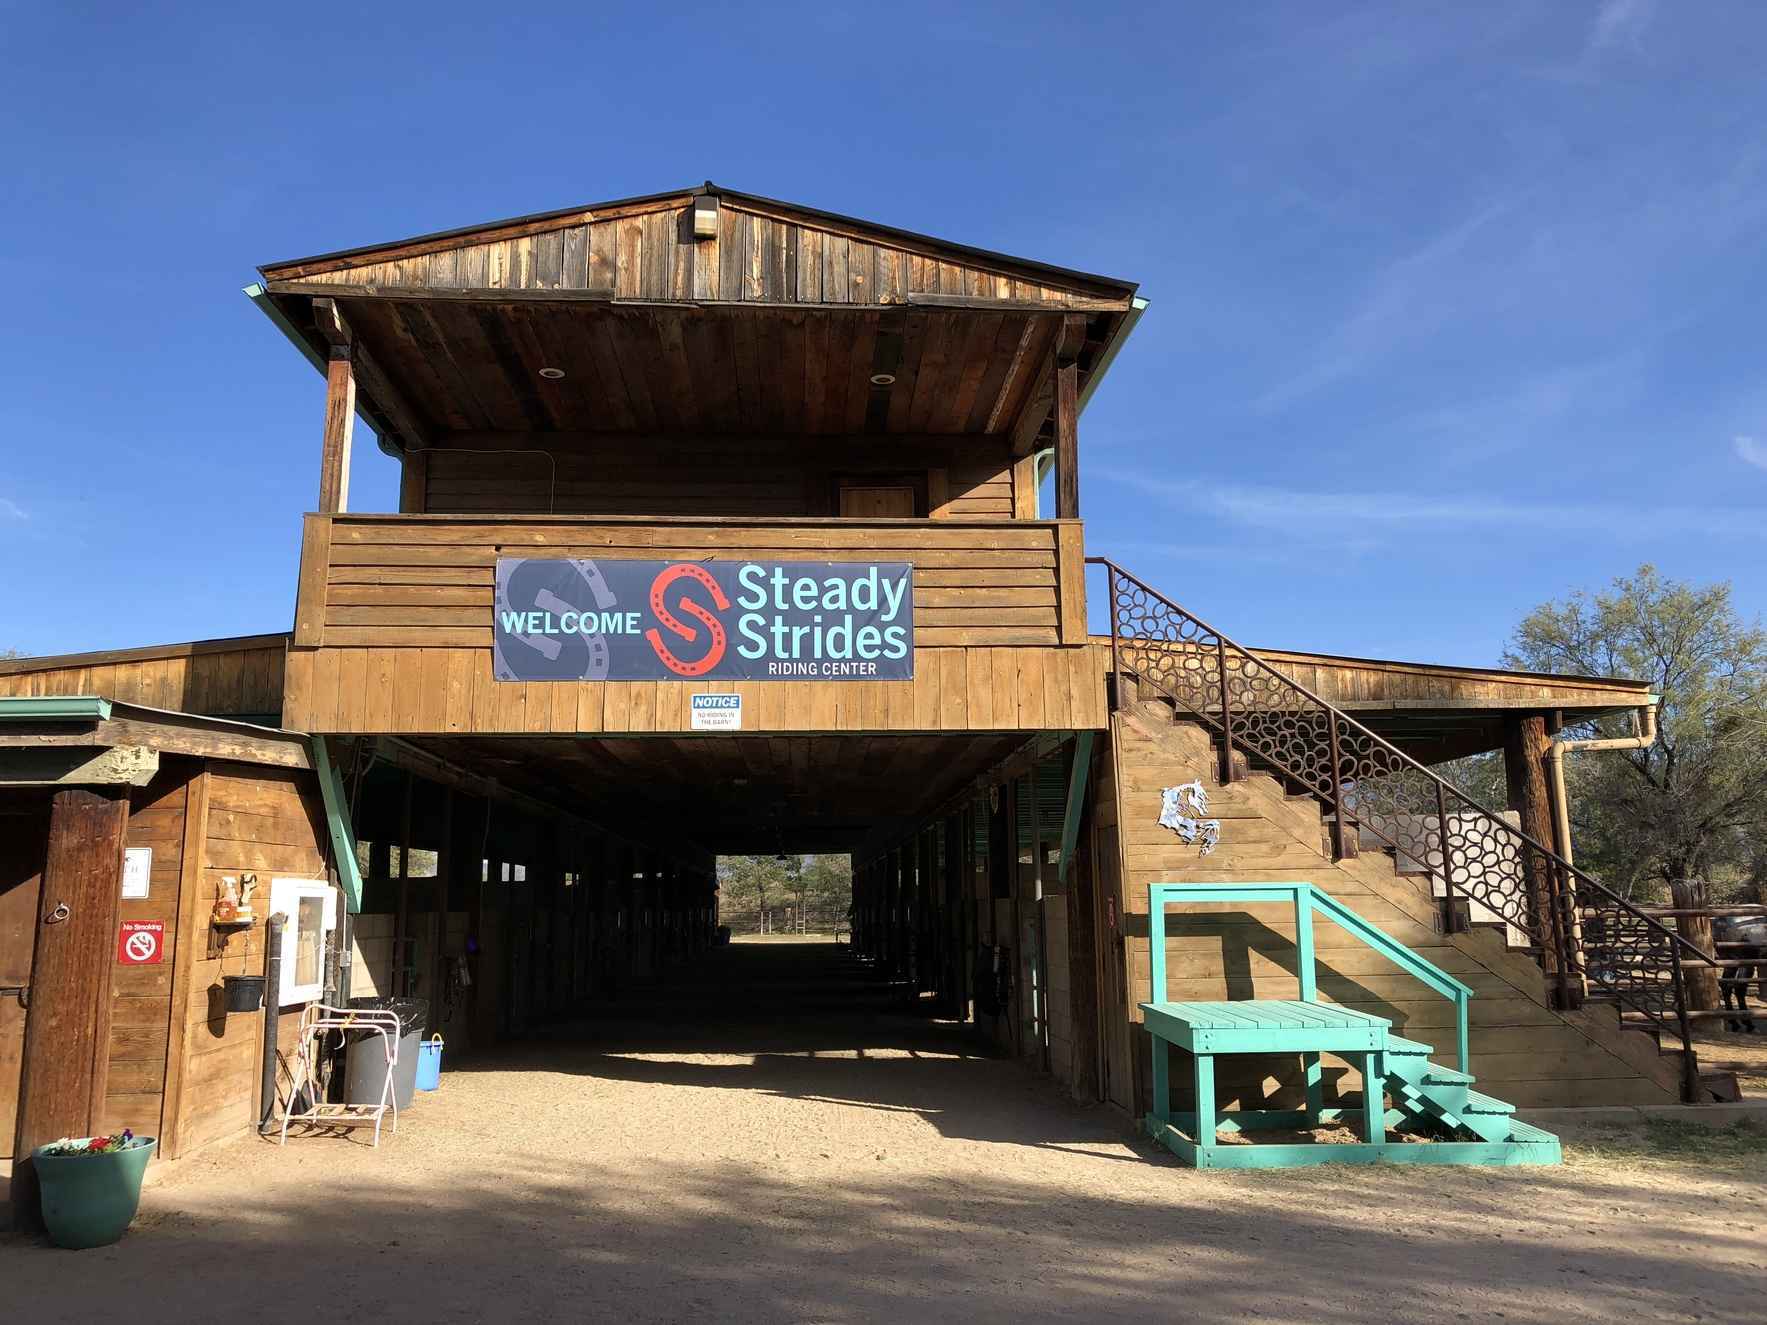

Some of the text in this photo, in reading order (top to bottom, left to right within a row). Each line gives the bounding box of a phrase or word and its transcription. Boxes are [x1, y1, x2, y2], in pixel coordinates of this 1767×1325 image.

[736, 564, 907, 622] Steady
[501, 611, 642, 634] WELCOME
[736, 613, 908, 659] Strides
[768, 662, 877, 676] RIDING CENTER
[694, 696, 738, 707] NOTICE
[122, 923, 162, 931] No Smoking
